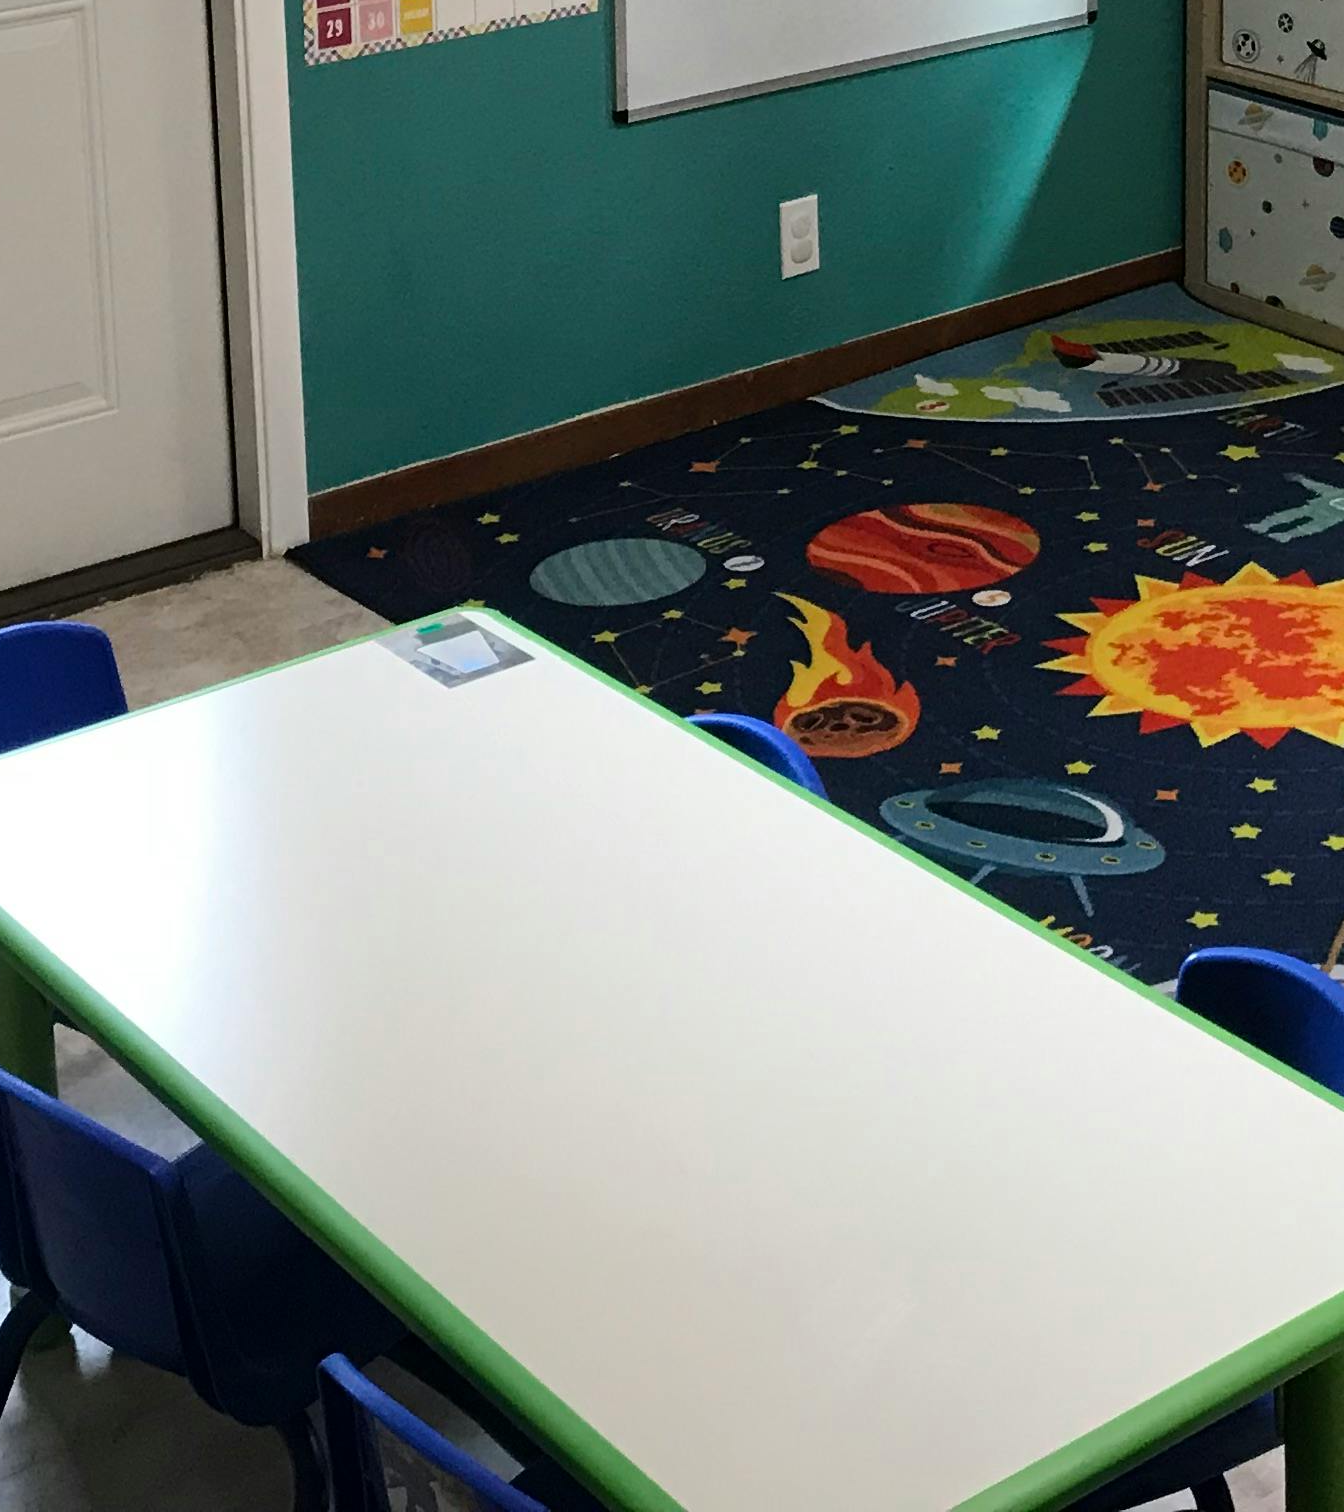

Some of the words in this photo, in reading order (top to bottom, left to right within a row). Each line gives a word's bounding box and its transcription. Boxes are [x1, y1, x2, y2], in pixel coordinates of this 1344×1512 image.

[326, 19, 343, 38] 29
[368, 12, 384, 30] 30
[1136, 529, 1229, 567] SUN
[896, 597, 1021, 654] JUPITER
